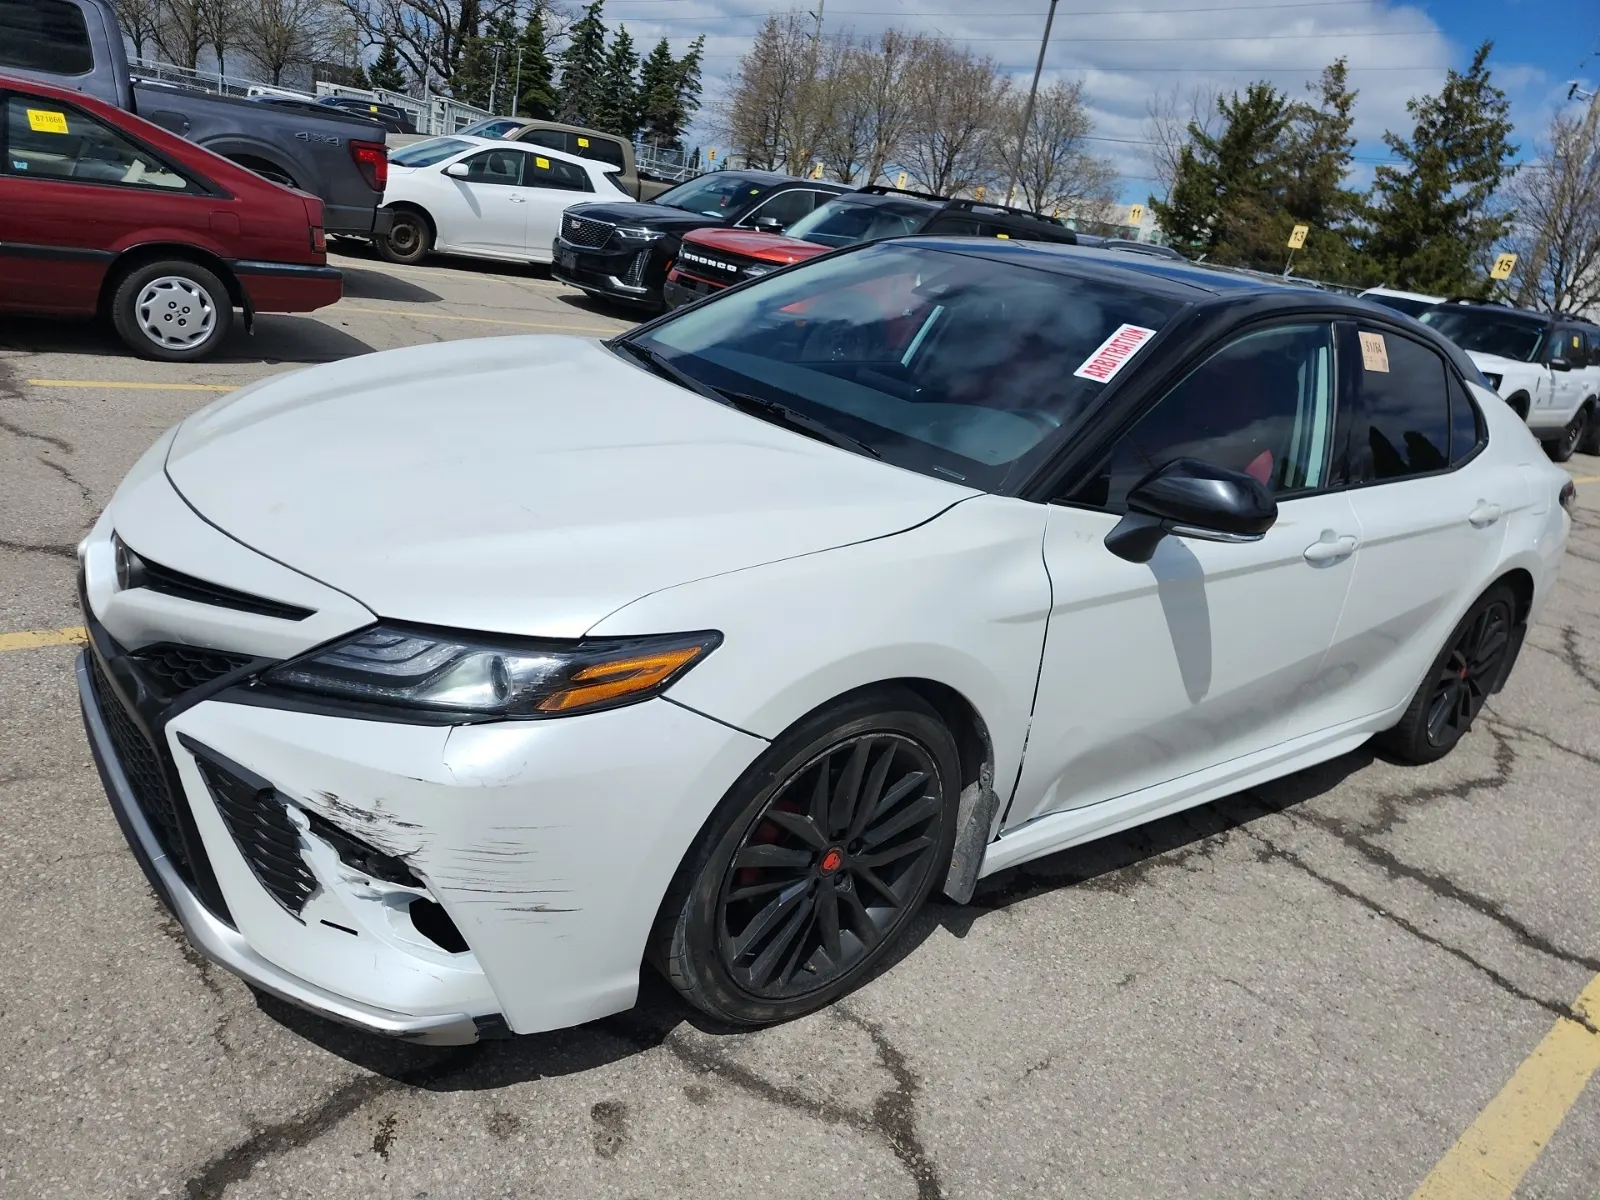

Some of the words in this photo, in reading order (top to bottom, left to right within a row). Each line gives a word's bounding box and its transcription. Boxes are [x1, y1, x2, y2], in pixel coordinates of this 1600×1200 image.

[1131, 208, 1141, 219] 11
[683, 252, 738, 273] BRONCO
[1498, 259, 1513, 272] 15
[1083, 327, 1149, 379] ARBITRATION
